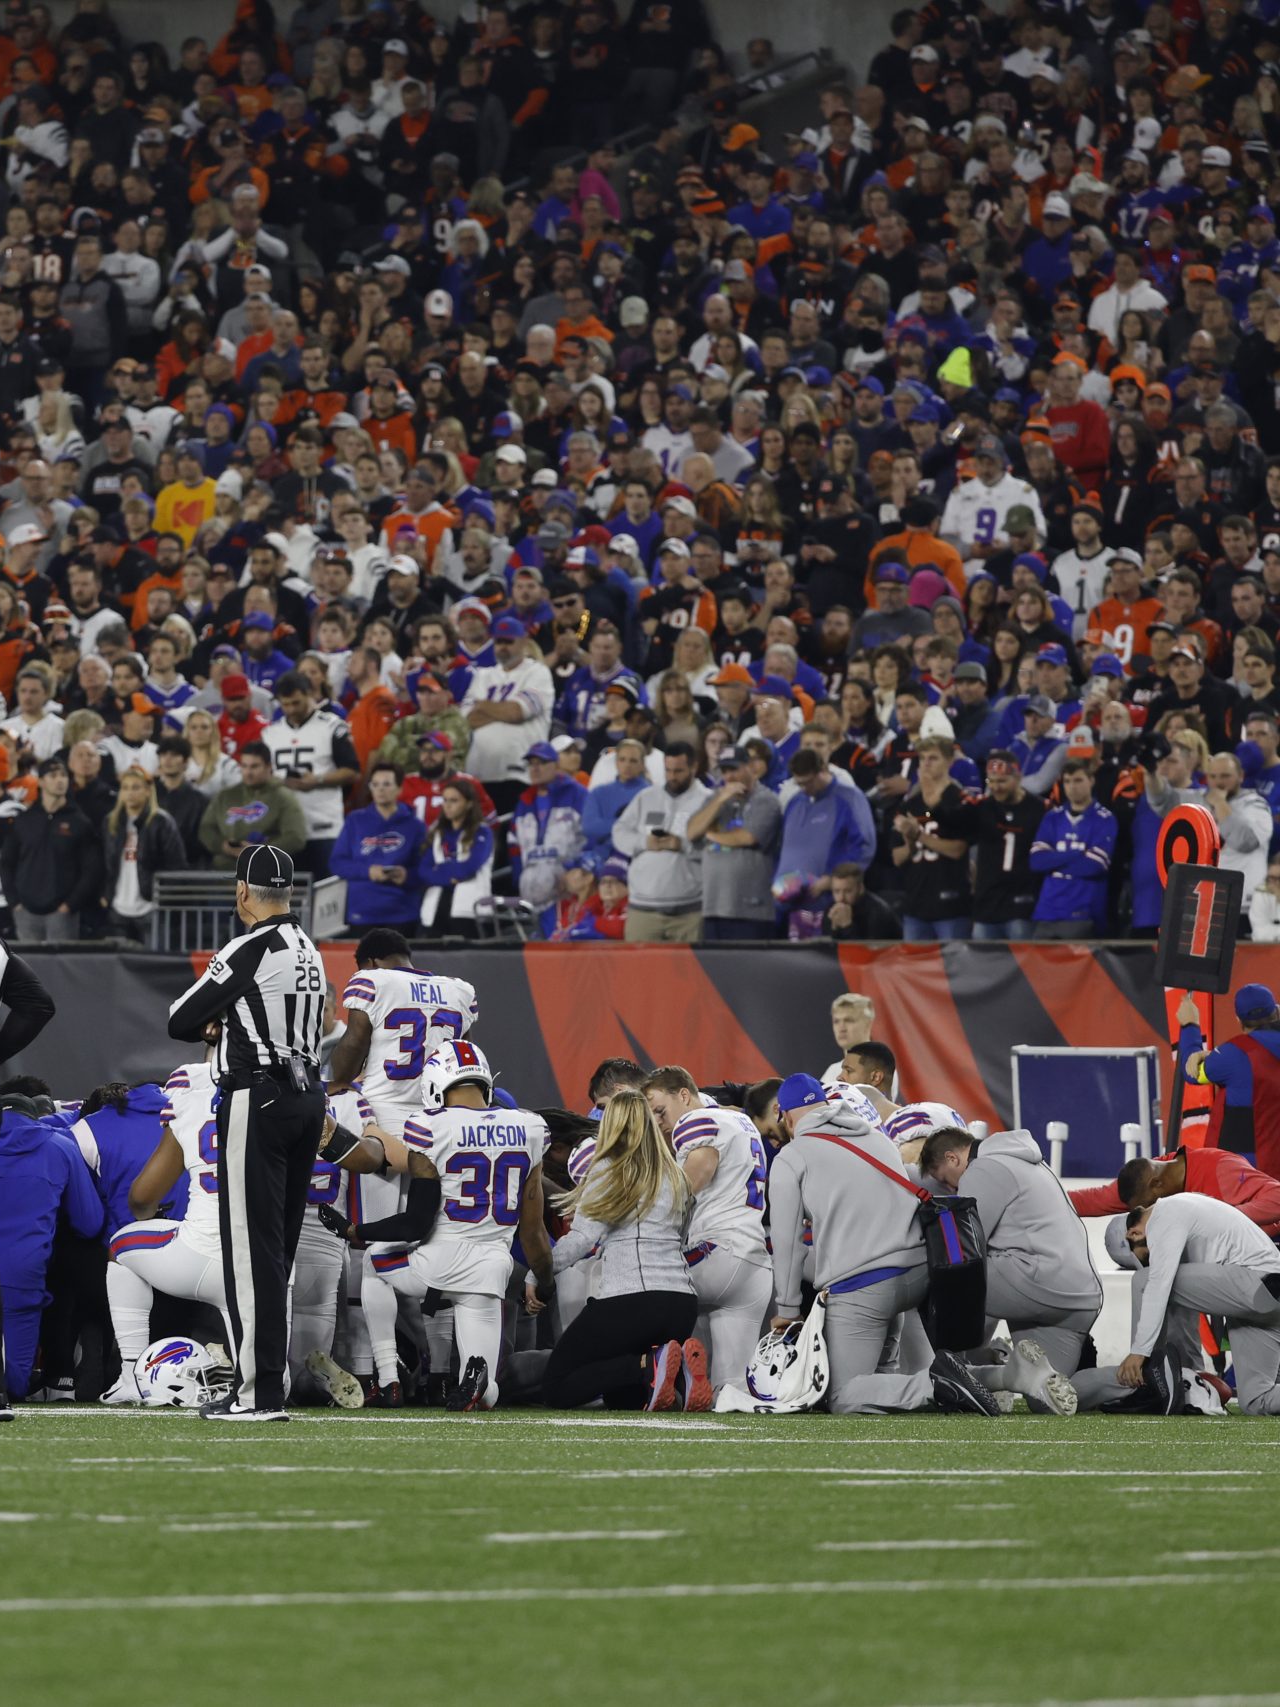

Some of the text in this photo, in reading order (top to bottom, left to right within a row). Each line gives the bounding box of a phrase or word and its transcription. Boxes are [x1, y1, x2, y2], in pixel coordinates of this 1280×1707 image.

[433, 218, 451, 253] 9
[1118, 206, 1150, 239] 17
[33, 252, 63, 282] 18
[1114, 485, 1131, 524] 1
[974, 508, 996, 544] 9
[1075, 578, 1087, 613] 1
[1114, 624, 1134, 665] 9
[275, 747, 314, 778] 55
[1002, 831, 1016, 872] 1
[1190, 880, 1217, 958] 1
[295, 965, 320, 992] 28
[411, 982, 447, 1005] NEAL
[457, 1125, 527, 1148] JACKSON
[444, 1151, 531, 1226] 30
[746, 1136, 768, 1211] 2
[58, 1376, 74, 1386] NIKE
